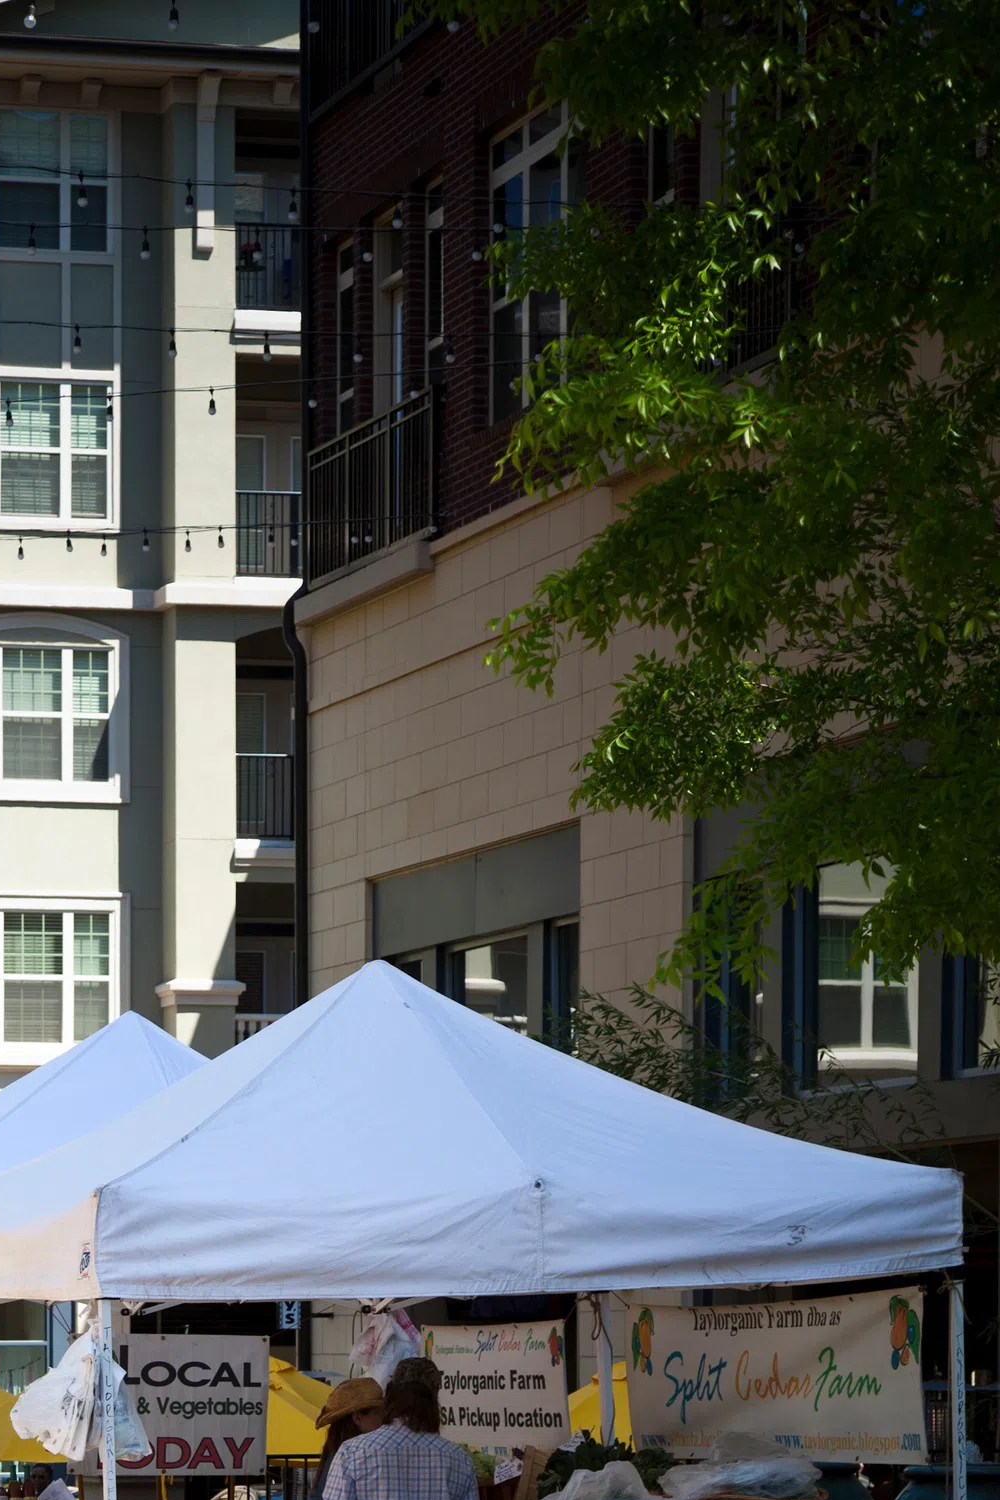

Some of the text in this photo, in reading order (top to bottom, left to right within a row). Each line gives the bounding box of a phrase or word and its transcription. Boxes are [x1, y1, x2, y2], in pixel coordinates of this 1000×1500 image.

[689, 1305, 842, 1336] Taylorganic Farm dba as
[474, 1329, 498, 1361] Split
[524, 1328, 546, 1356] Farm
[120, 1345, 261, 1388] LOCAL
[439, 1370, 546, 1395] Taylorganic Farm
[664, 1346, 882, 1425] Split Cedar Farm
[137, 1397, 263, 1419] & Vegetables
[440, 1406, 563, 1432] SA Pickup location
[97, 1437, 255, 1469] ODAY
